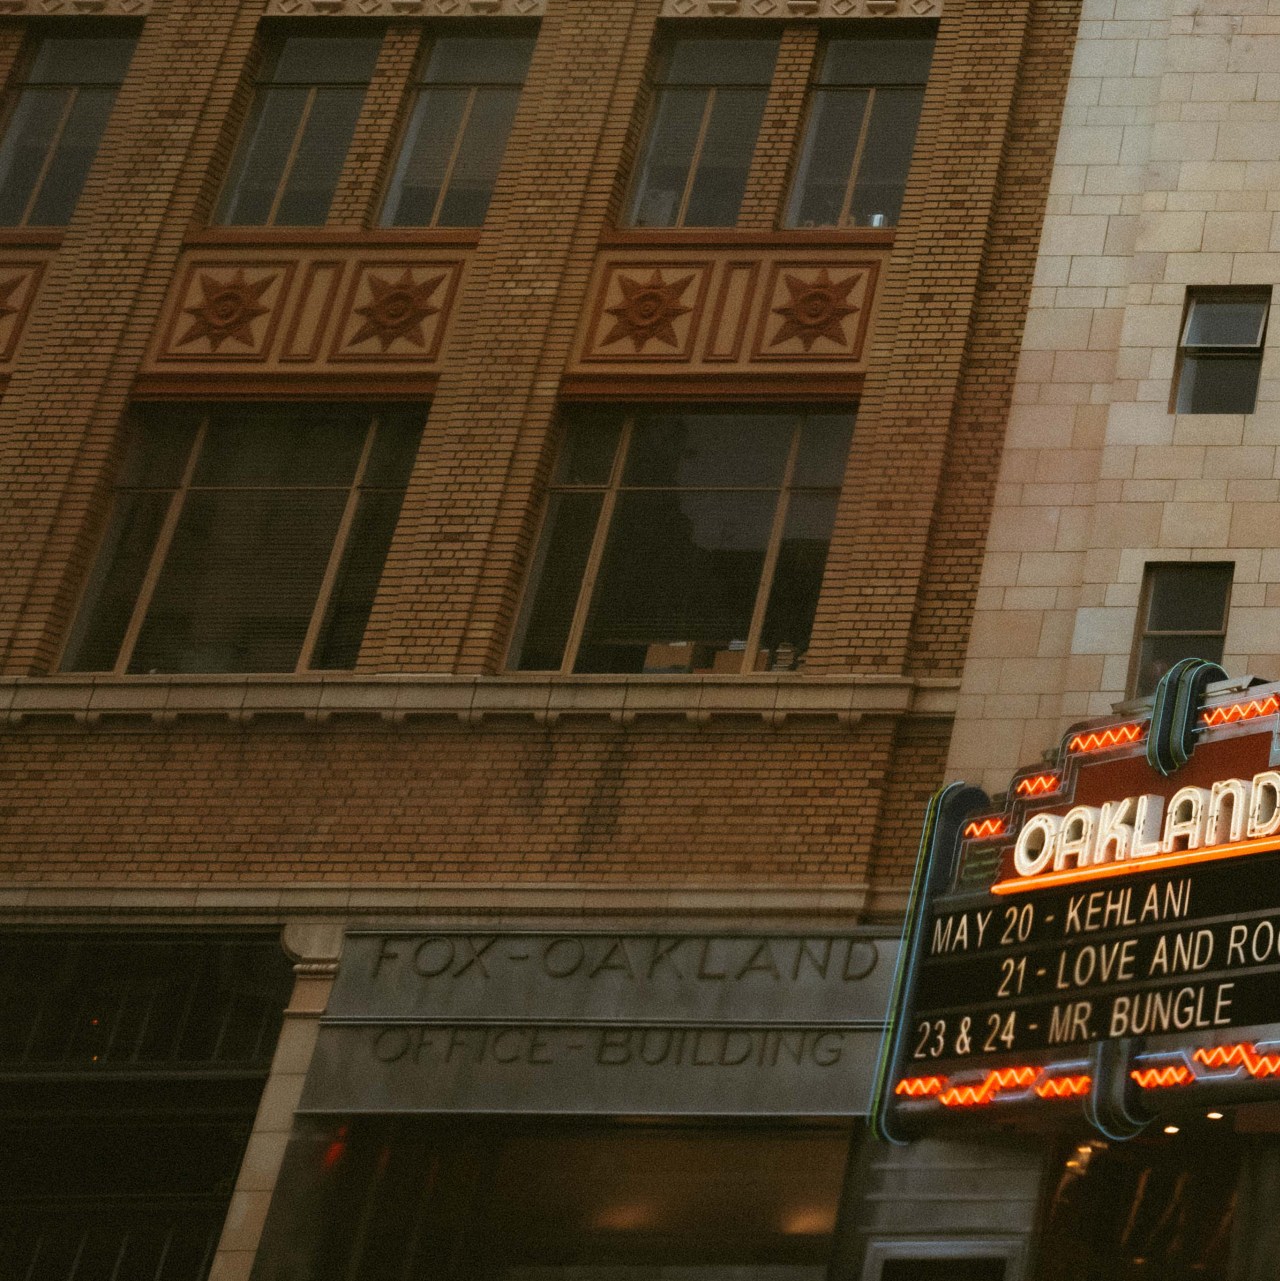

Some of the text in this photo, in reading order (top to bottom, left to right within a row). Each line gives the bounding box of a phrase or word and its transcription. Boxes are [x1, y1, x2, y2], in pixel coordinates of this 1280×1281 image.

[932, 911, 992, 956] MAY
[1000, 902, 1034, 946] 20
[1065, 877, 1193, 935] KEHLANI
[997, 956, 1027, 998] 21
[1056, 939, 1138, 990] LOVE
[1149, 929, 1215, 976] AND
[914, 1017, 946, 1060] 23
[955, 1015, 973, 1056] &
[983, 1010, 1016, 1054] 24
[1047, 1001, 1097, 1044] MR.
[1109, 982, 1236, 1038] BUNGLE
